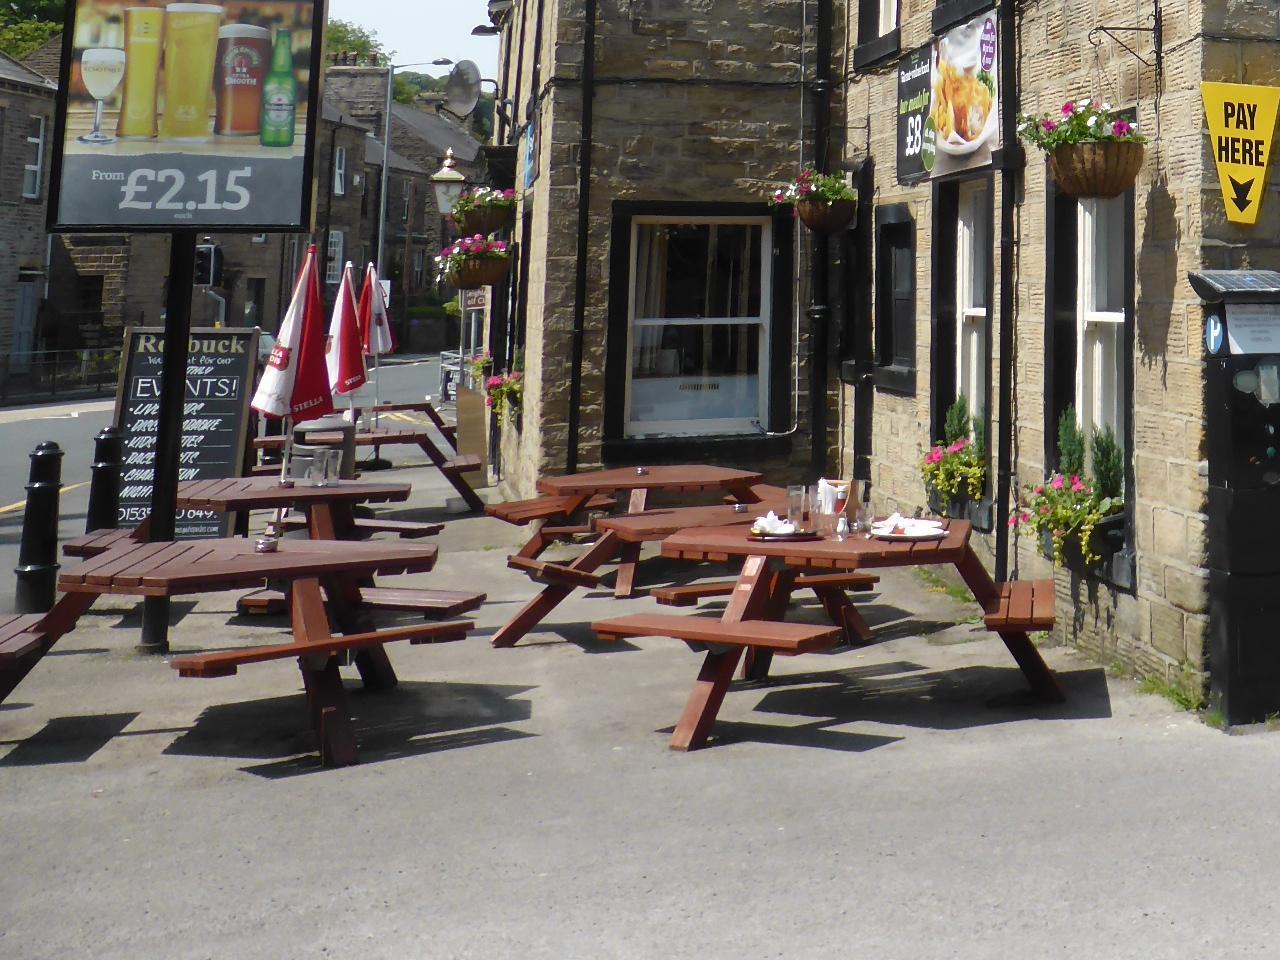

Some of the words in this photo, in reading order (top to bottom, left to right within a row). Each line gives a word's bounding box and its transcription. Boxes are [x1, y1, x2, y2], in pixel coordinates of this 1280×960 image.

[1223, 101, 1258, 131] PAY
[905, 114, 922, 157] £8
[1217, 136, 1265, 167] HERE
[91, 169, 125, 181] From
[118, 166, 252, 211] £2.15
[136, 378, 238, 397] EVNTS!
[293, 395, 324, 413] STELLA
